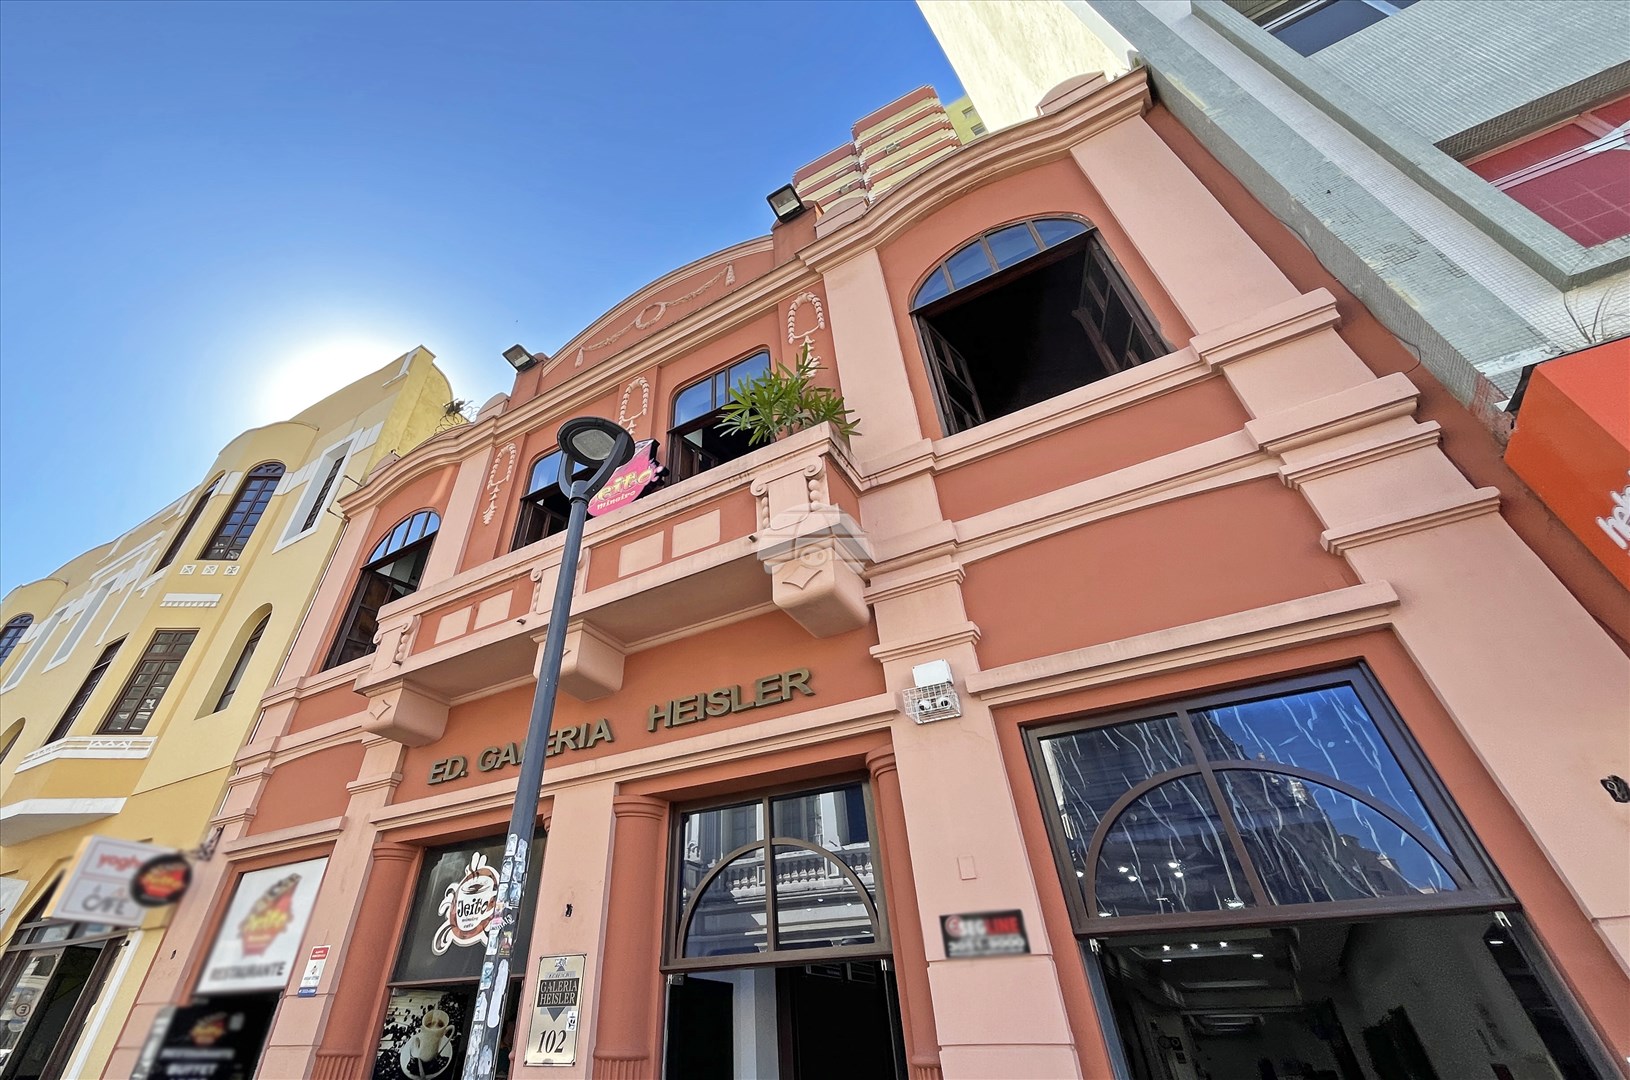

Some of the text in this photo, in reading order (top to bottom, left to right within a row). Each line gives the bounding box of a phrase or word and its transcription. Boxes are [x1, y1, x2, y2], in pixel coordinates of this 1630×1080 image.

[427, 667, 817, 785] ED. GAERIA HEISLER
[457, 898, 489, 918] Jeito
[540, 980, 578, 993] GALERIA
[540, 992, 576, 1006] HEISLER
[536, 1029, 567, 1054] 102
